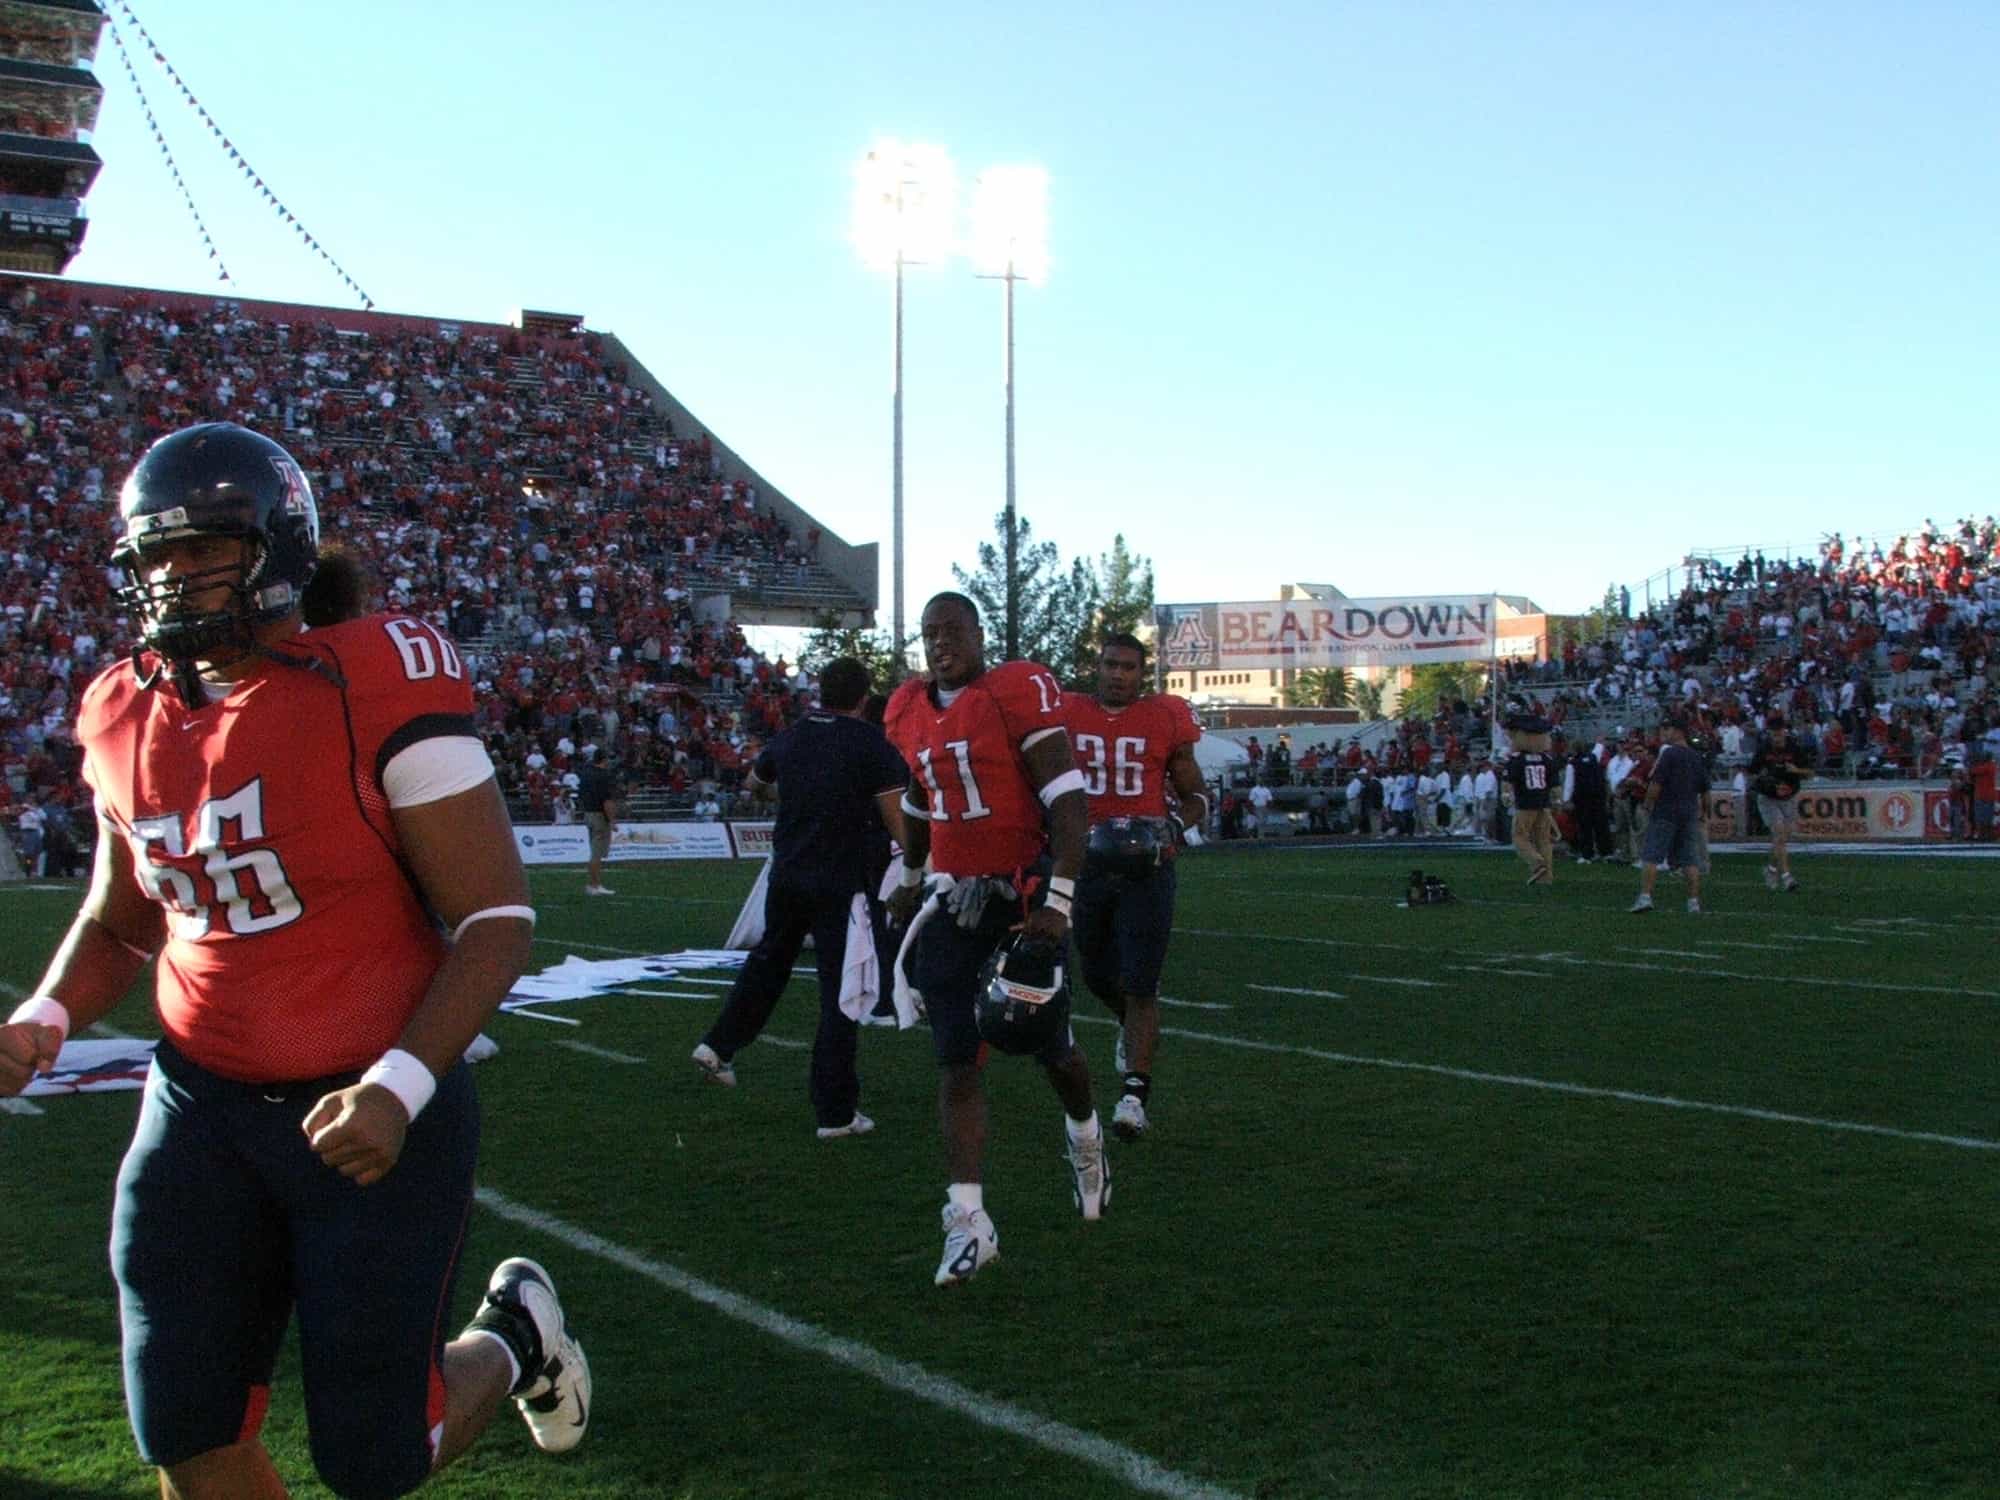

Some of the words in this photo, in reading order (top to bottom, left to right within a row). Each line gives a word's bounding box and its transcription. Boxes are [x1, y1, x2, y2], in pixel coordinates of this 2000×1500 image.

[916, 739, 991, 821] 11
[1076, 734, 1146, 796] 36
[130, 773, 304, 943] 66
